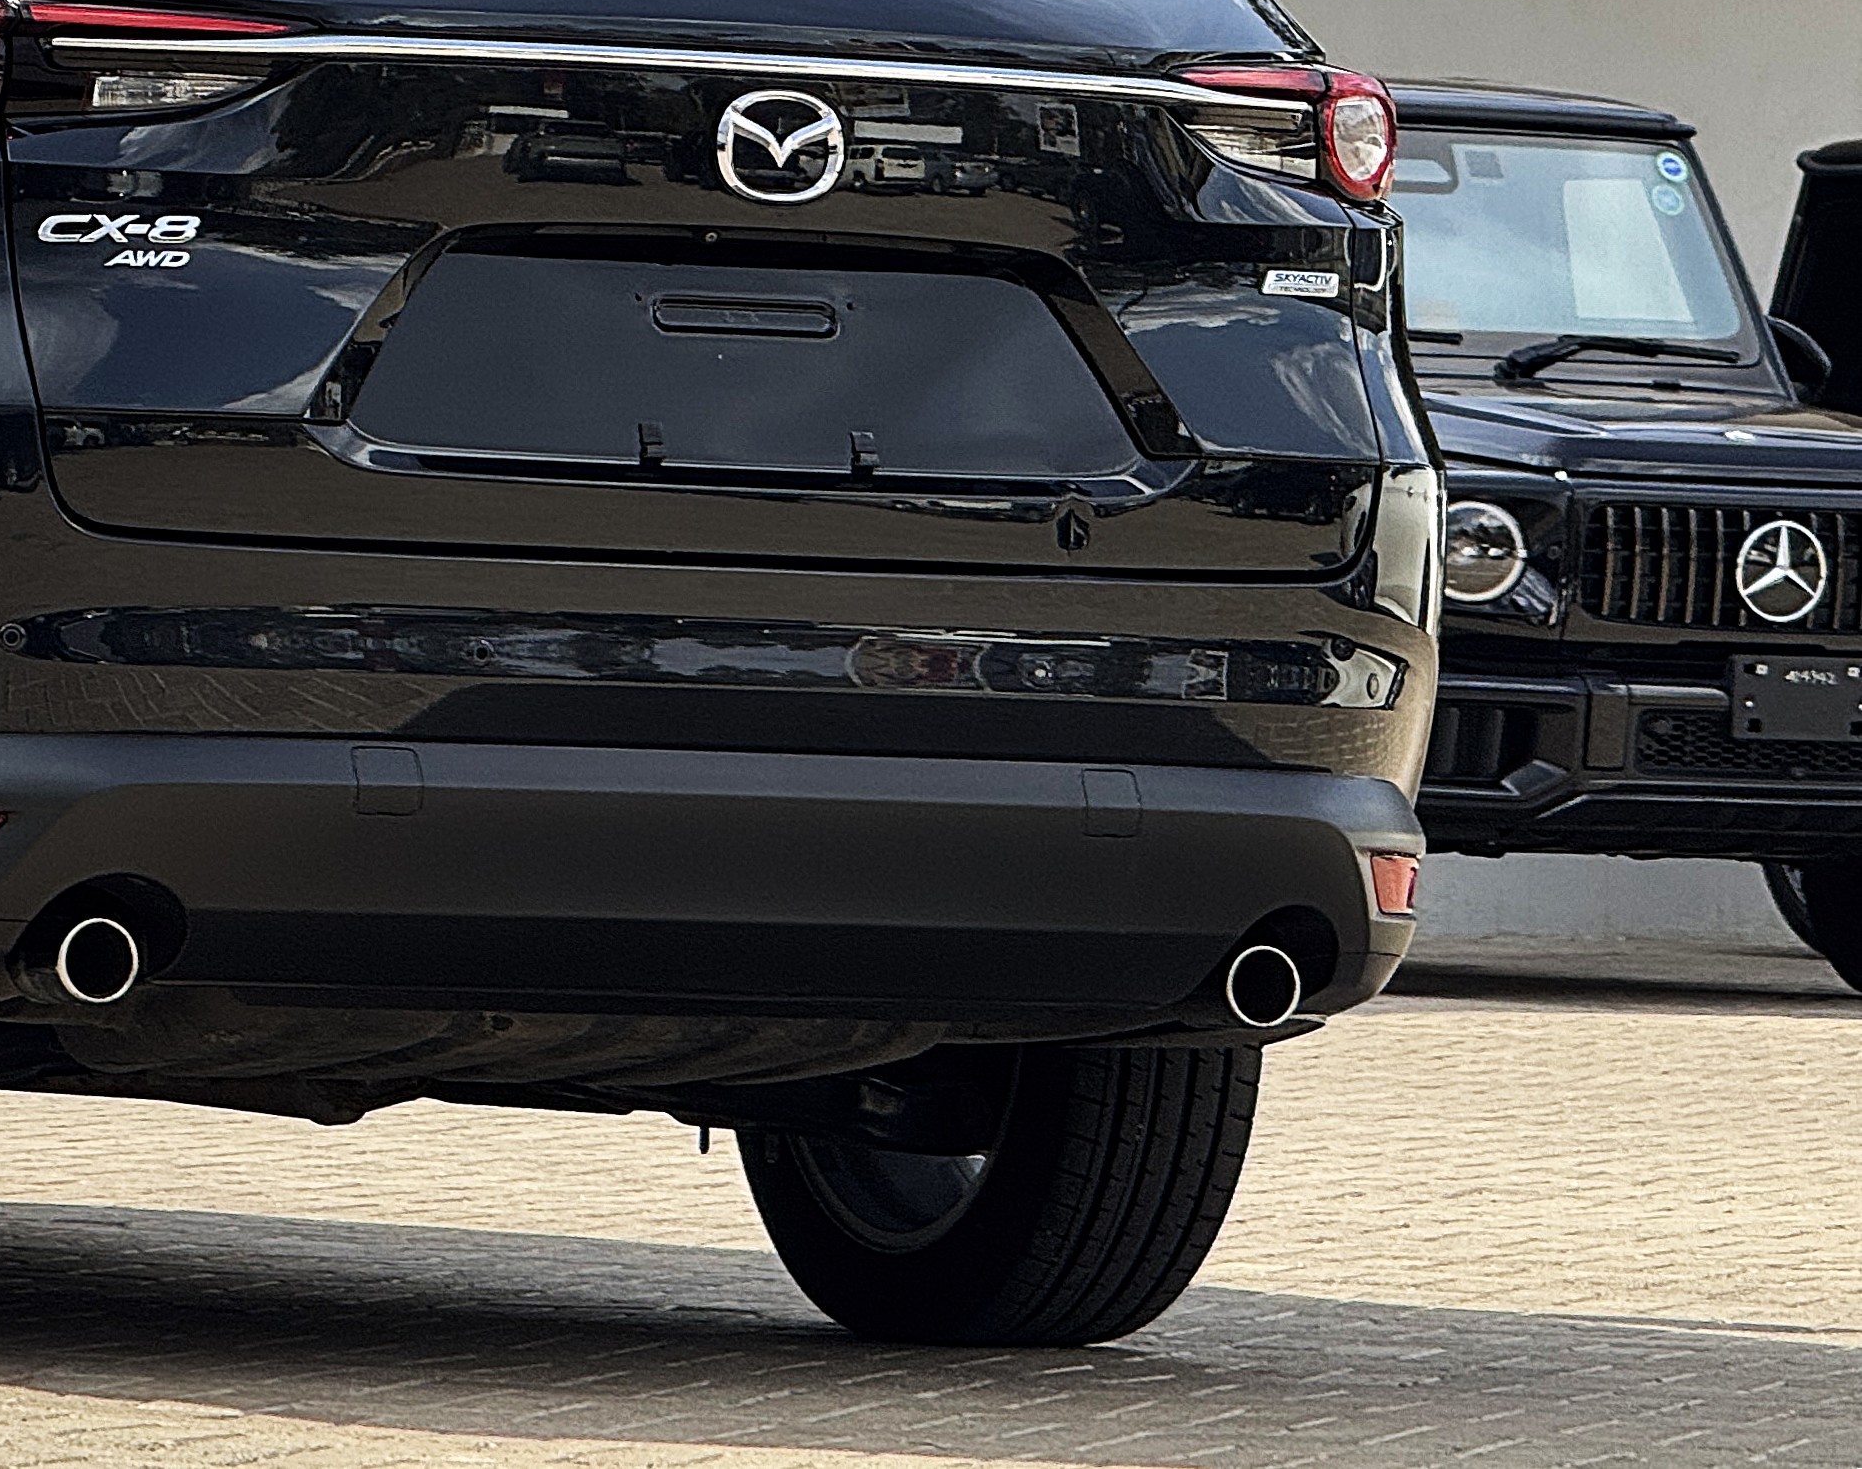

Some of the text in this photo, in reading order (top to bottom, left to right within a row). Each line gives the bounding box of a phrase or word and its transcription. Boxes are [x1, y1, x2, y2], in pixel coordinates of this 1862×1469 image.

[38, 214, 201, 244] CX-8
[104, 249, 191, 267] AWD
[1273, 273, 1333, 285] SKYACTIV
